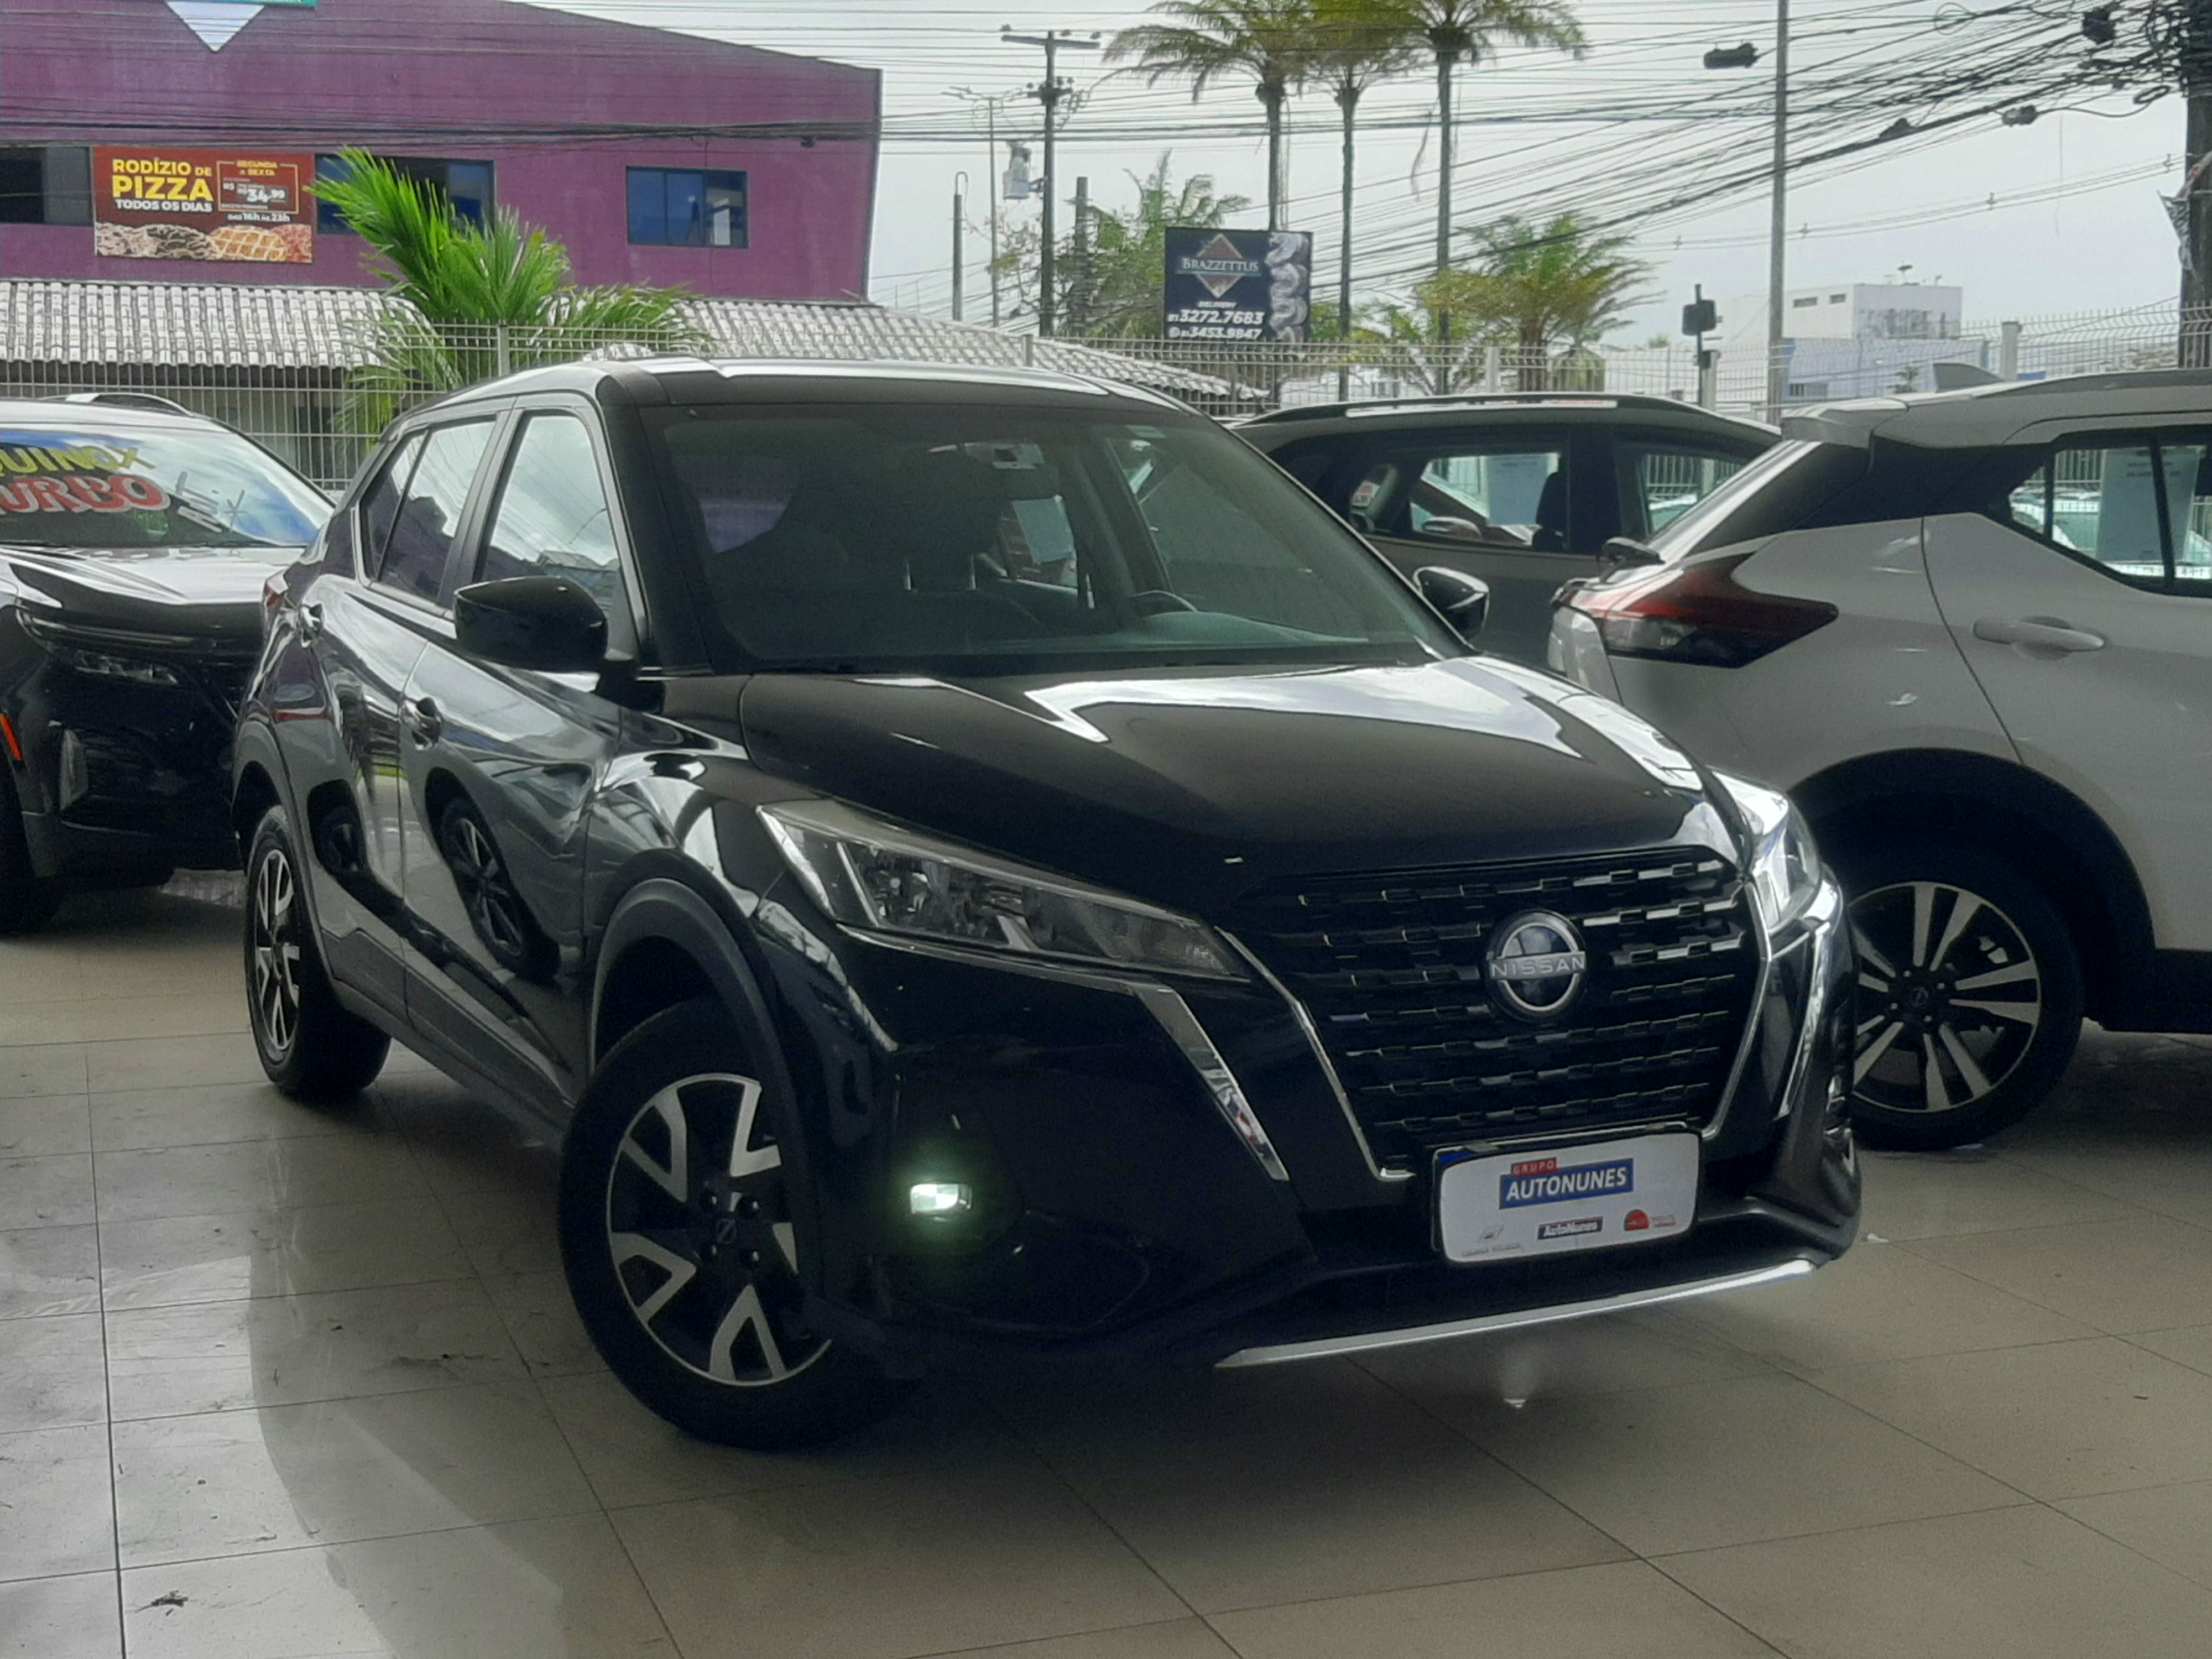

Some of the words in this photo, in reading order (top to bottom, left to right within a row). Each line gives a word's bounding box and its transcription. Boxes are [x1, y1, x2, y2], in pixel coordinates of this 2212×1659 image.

[113, 157, 191, 175] RODÍZIO
[195, 167, 212, 176] DE
[113, 175, 214, 201] PIZZA
[115, 199, 160, 211] TODOS
[163, 200, 180, 211] OS
[181, 201, 213, 212] DIAS
[0, 446, 156, 477] UINOX
[0, 476, 171, 515] URBO
[1491, 956, 1585, 977] NISSAN
[1512, 1160, 1555, 1176] GRUPO
[1506, 1167, 1626, 1201] AUTONUNES
